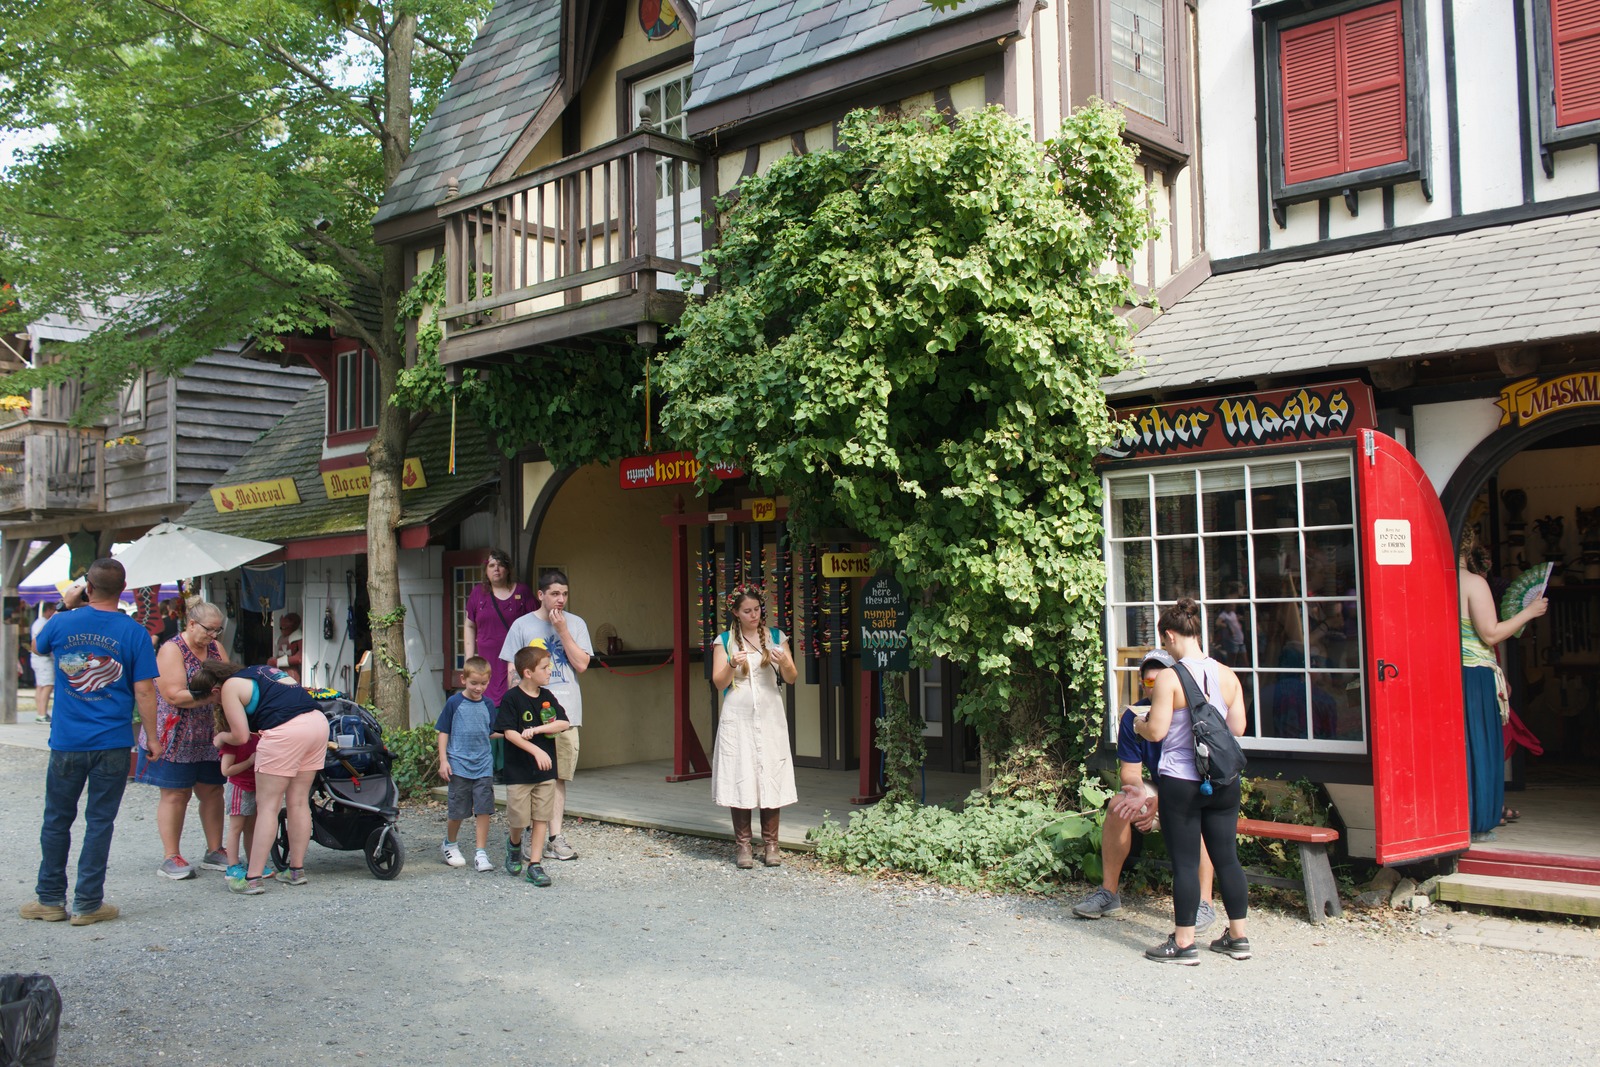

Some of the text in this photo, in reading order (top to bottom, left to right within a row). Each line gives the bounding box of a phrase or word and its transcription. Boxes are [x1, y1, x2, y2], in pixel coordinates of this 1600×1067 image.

[1099, 389, 1349, 458] ther Masks
[626, 464, 655, 484] nymph
[330, 474, 371, 496] Mocca
[235, 483, 286, 508] Medieval
[831, 555, 870, 573] horns
[872, 587, 892, 596] here
[876, 579, 888, 588] ah!
[865, 593, 900, 605] they are!
[863, 607, 897, 620] nymph
[871, 618, 897, 628] satyr
[67, 633, 119, 647] DISTRICT
[861, 626, 908, 649] horns
